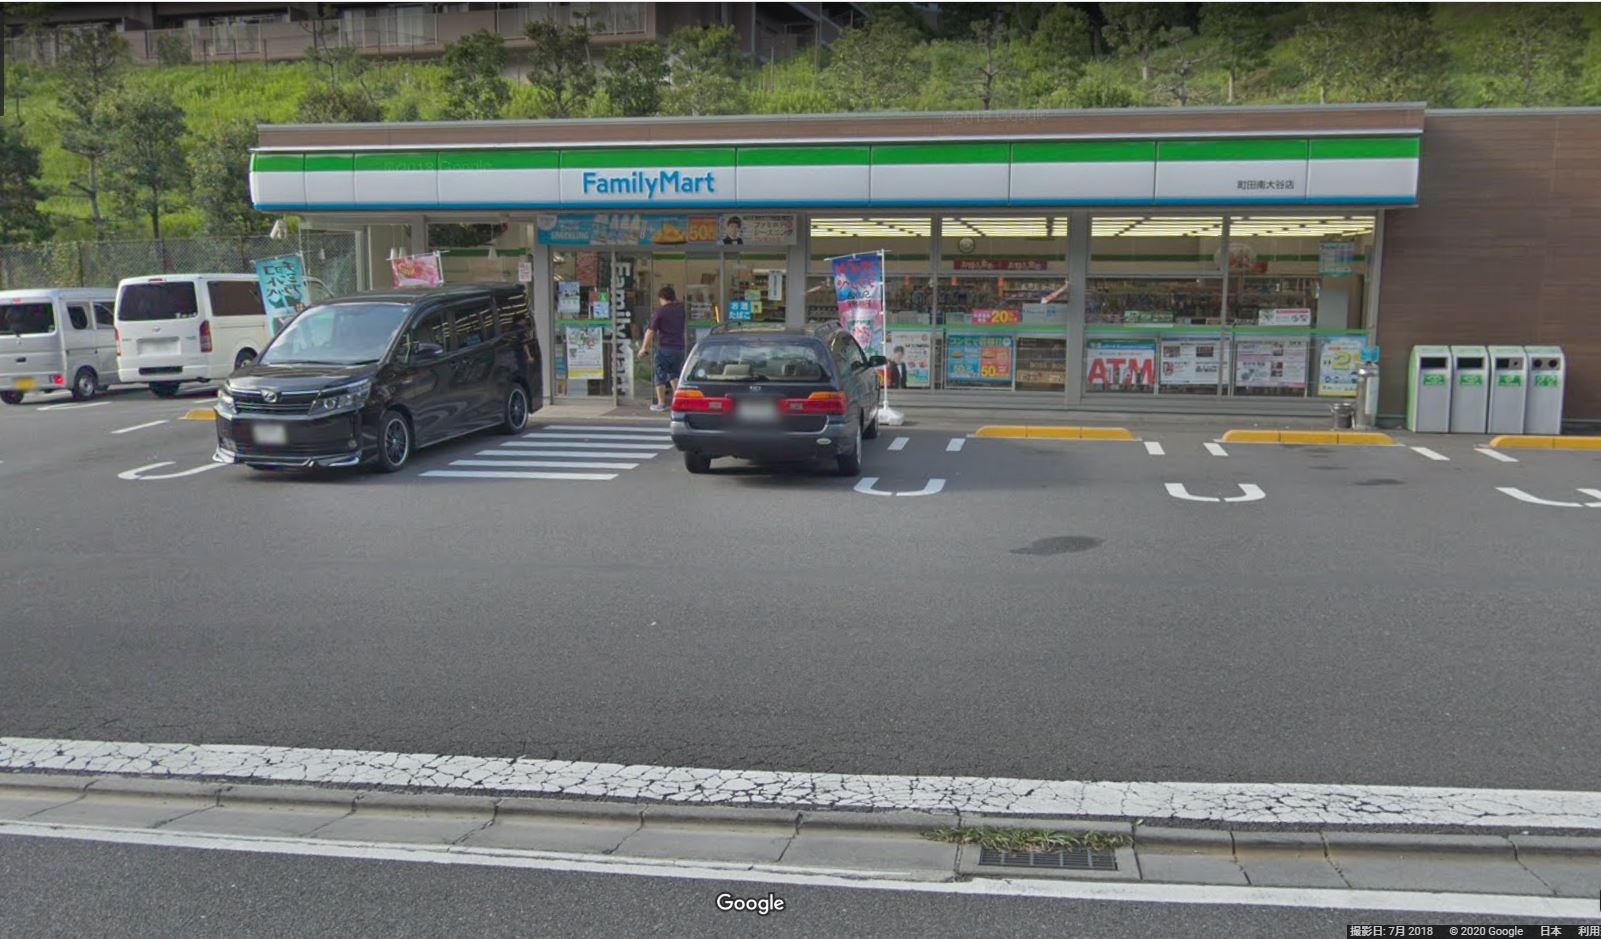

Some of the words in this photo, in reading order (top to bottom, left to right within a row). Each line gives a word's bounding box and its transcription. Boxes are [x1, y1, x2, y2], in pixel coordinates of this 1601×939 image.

[583, 170, 715, 199] FamilyMart
[1237, 180, 1295, 190] 町田南大谷店
[1088, 357, 1155, 385] ATM
